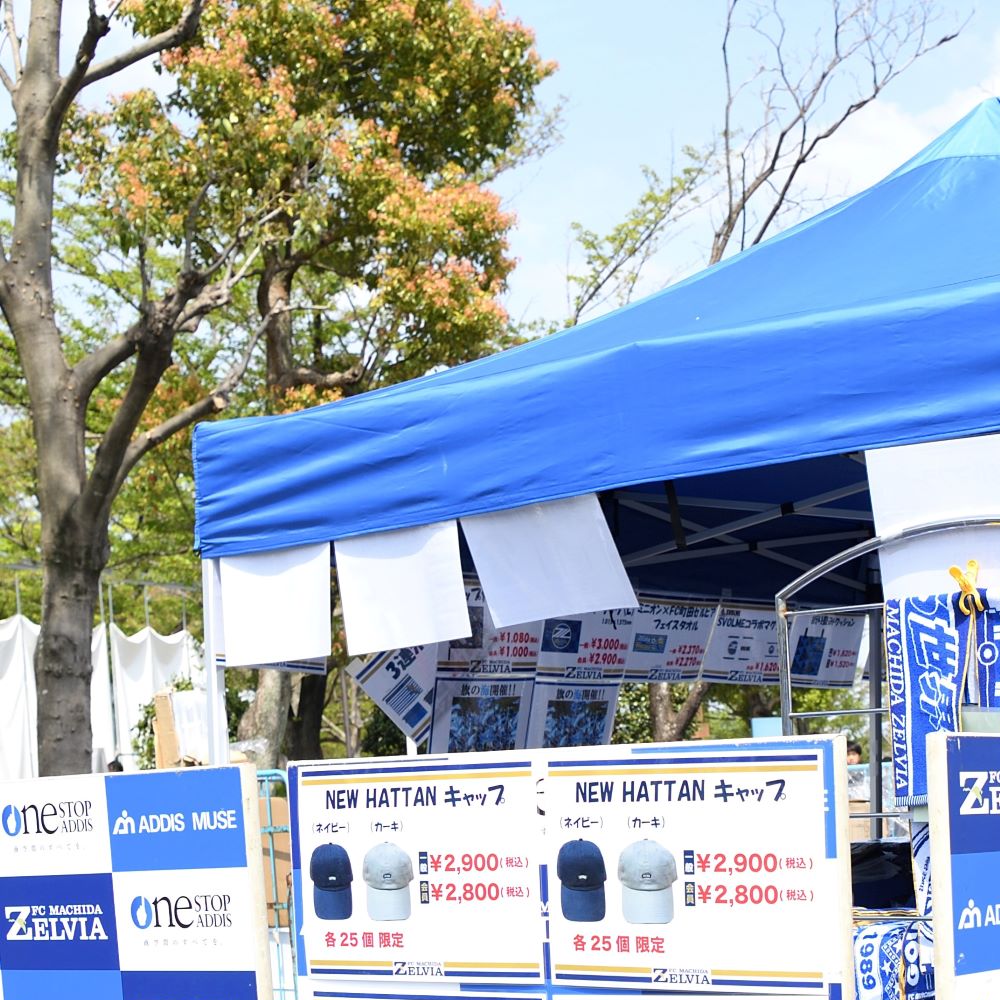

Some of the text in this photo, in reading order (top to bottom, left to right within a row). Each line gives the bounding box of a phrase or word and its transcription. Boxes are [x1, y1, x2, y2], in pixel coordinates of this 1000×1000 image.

[469, 659, 512, 674] ZELVIA
[564, 666, 604, 680] ZELVIA
[885, 605, 911, 791] MACHIDA ZELVIA
[325, 783, 506, 811] NEW HATTAN キャップ
[575, 778, 787, 804] NEW HATTAN キャップ
[58, 800, 93, 818] STOP
[60, 817, 94, 834] ADDIS
[138, 808, 238, 834] ADDIS MUSE
[32, 903, 104, 917] FC MACHIDA
[193, 893, 232, 913] STOP
[4, 904, 109, 942] ZELVIA
[196, 911, 233, 930] ADDIS
[393, 961, 444, 978] ZELVIA
[859, 931, 877, 991] 1989
[652, 967, 711, 986] ZELVIA
